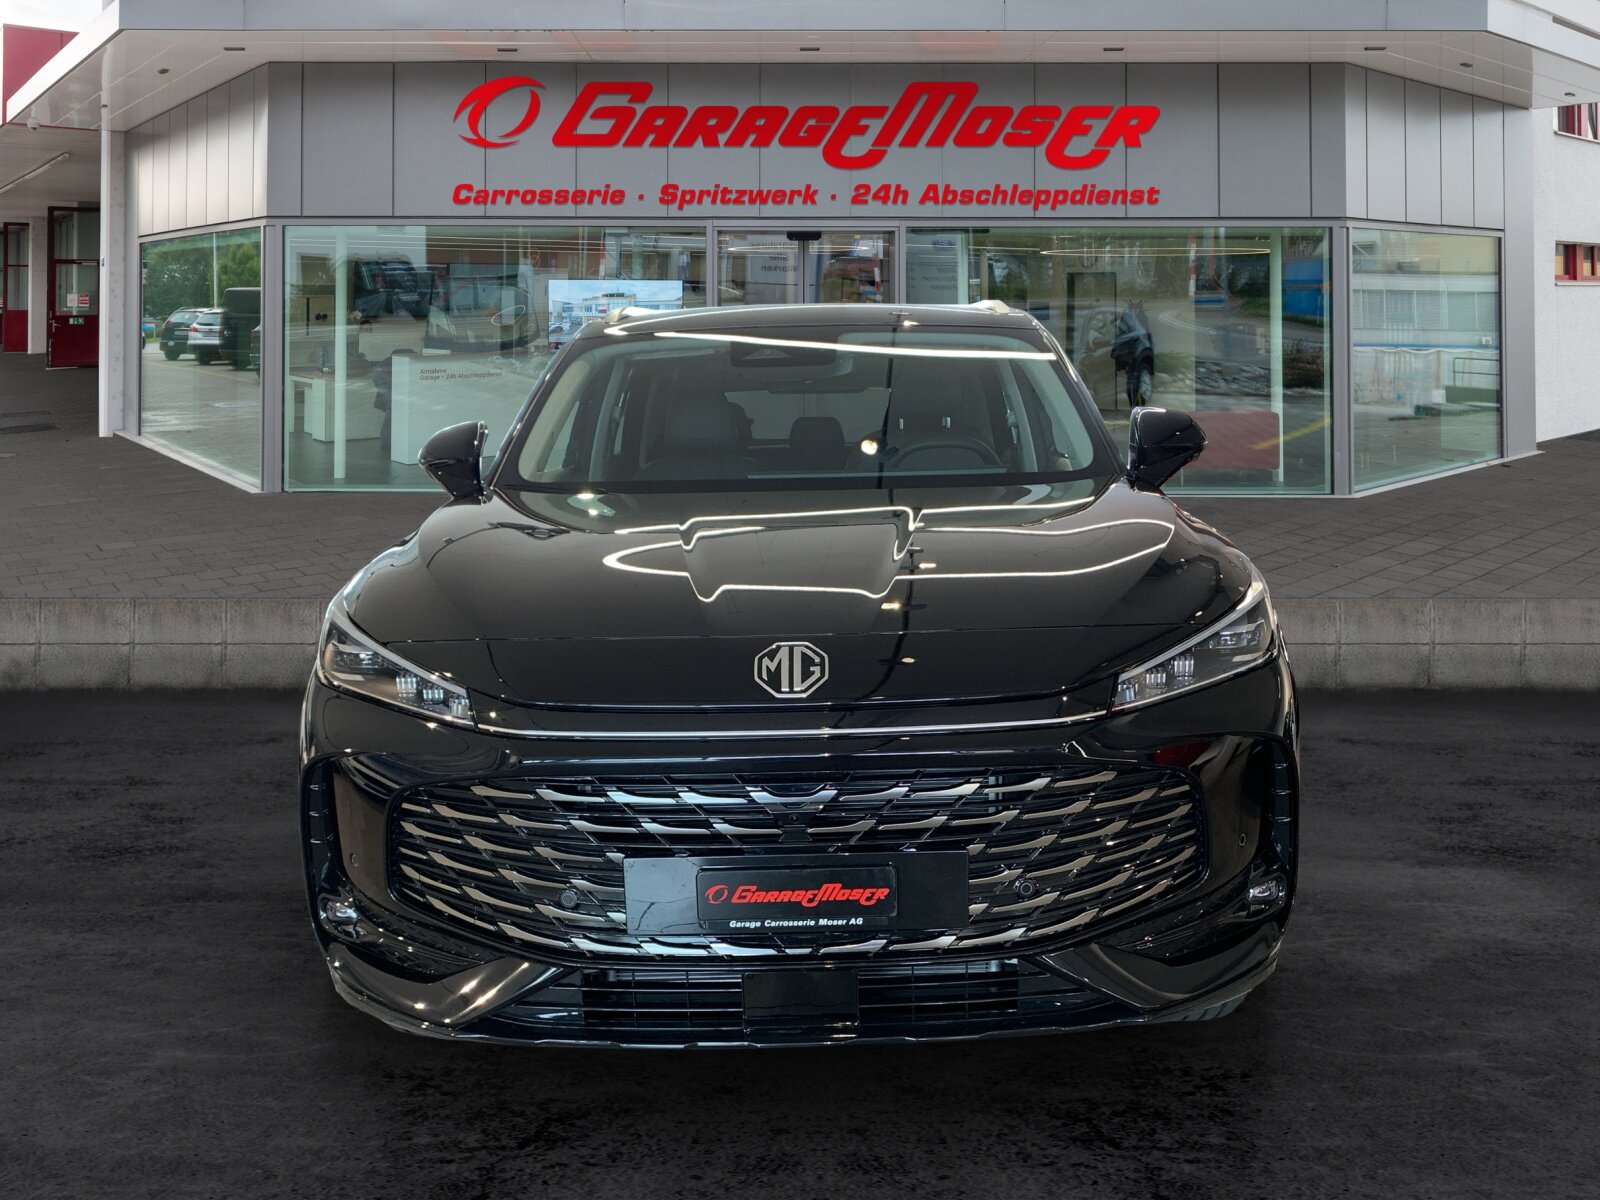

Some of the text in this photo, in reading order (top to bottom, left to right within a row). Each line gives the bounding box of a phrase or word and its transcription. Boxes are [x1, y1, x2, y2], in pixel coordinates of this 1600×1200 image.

[452, 183, 1160, 210] Carrosserie Spritzwerk 24h Abschleppdienst
[761, 646, 821, 692] MG
[729, 917, 864, 928] Garage Carrosserie Moser AG
